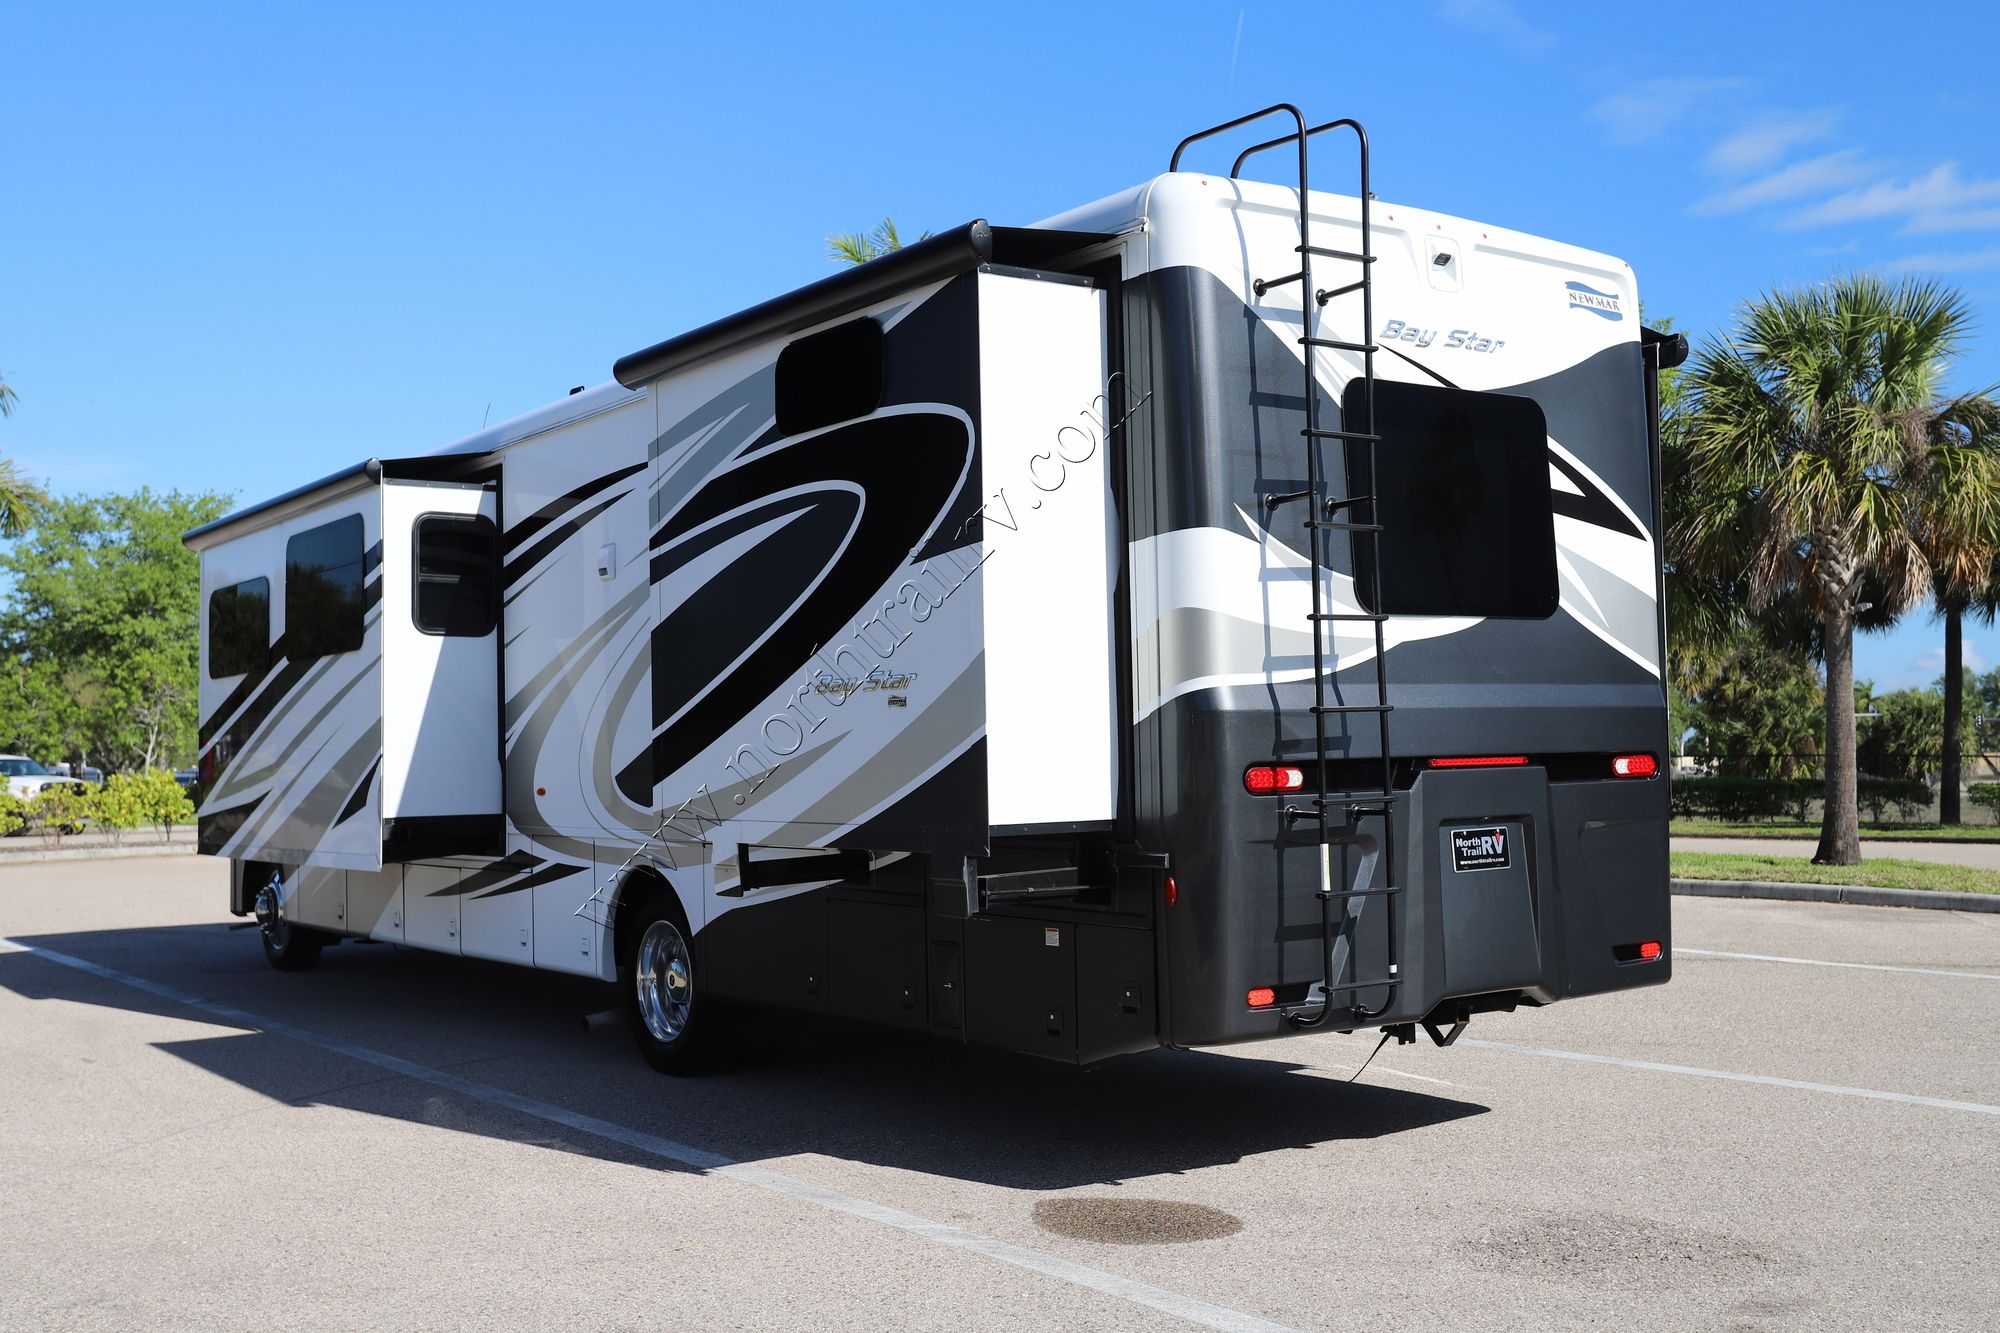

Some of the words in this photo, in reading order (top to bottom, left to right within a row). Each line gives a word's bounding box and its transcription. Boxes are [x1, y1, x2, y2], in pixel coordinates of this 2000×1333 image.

[1569, 292, 1621, 312] NEWMAR
[1380, 319, 1437, 348] Bay
[1443, 329, 1505, 353] Star
[814, 674, 858, 696] Bay
[863, 669, 918, 692] Star
[1455, 837, 1481, 847] North
[1461, 847, 1482, 857] Trail
[1481, 835, 1504, 855] RV
